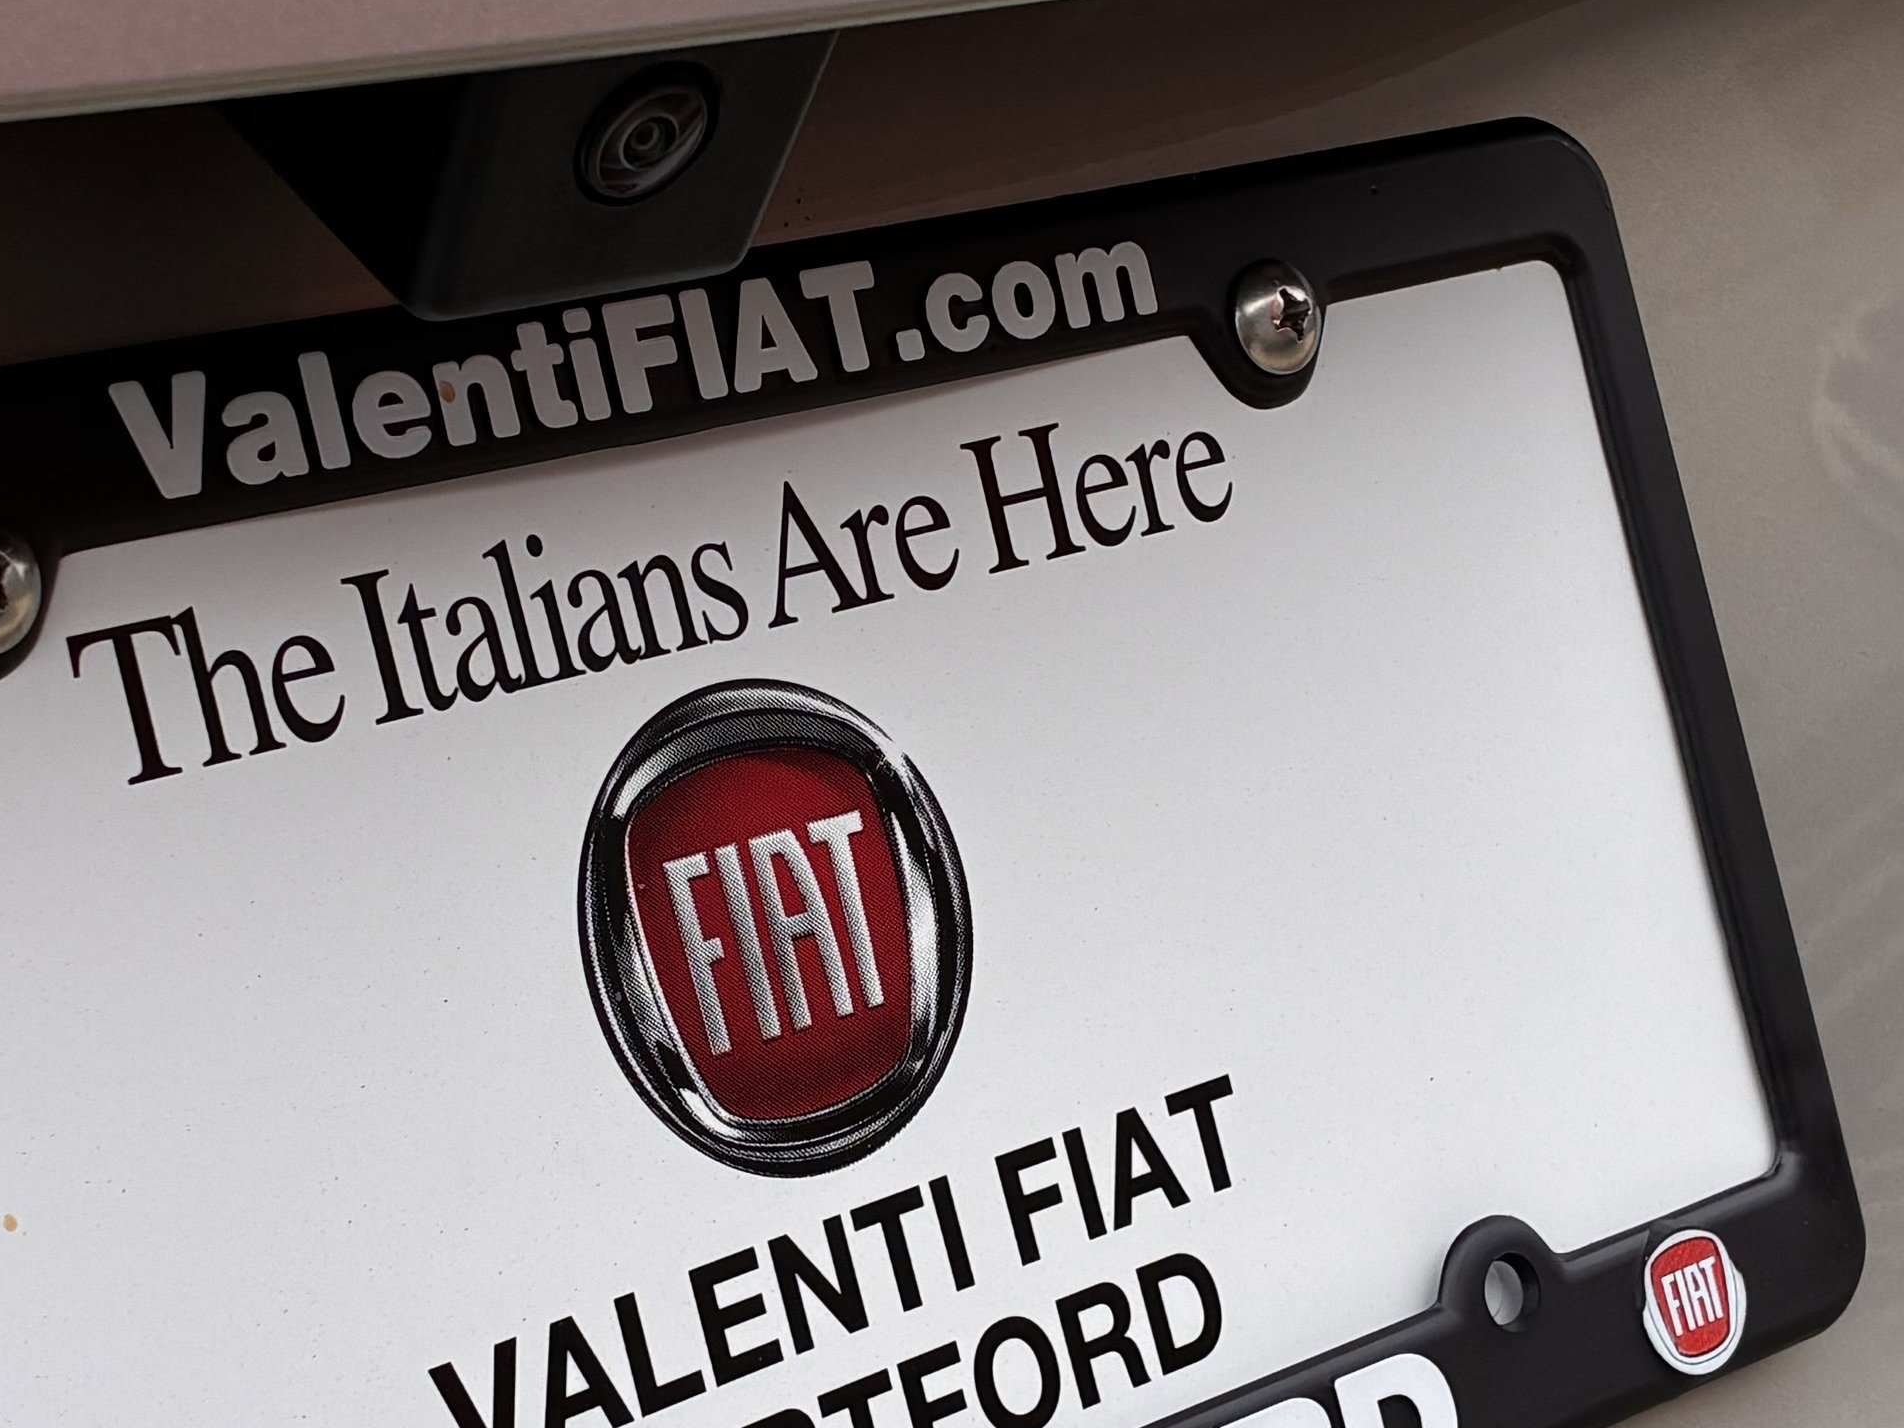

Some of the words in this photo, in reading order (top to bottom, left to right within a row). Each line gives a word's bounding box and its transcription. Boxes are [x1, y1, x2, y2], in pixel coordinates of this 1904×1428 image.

[108, 238, 1158, 500] ValentiFIAT.com
[67, 605, 346, 786] The
[340, 534, 749, 727] Italians
[767, 479, 961, 630] Are
[960, 422, 1234, 574] Here
[661, 809, 884, 1056] FIAT
[995, 1074, 1235, 1266] FIAT
[1660, 1255, 1724, 1338] FIAT
